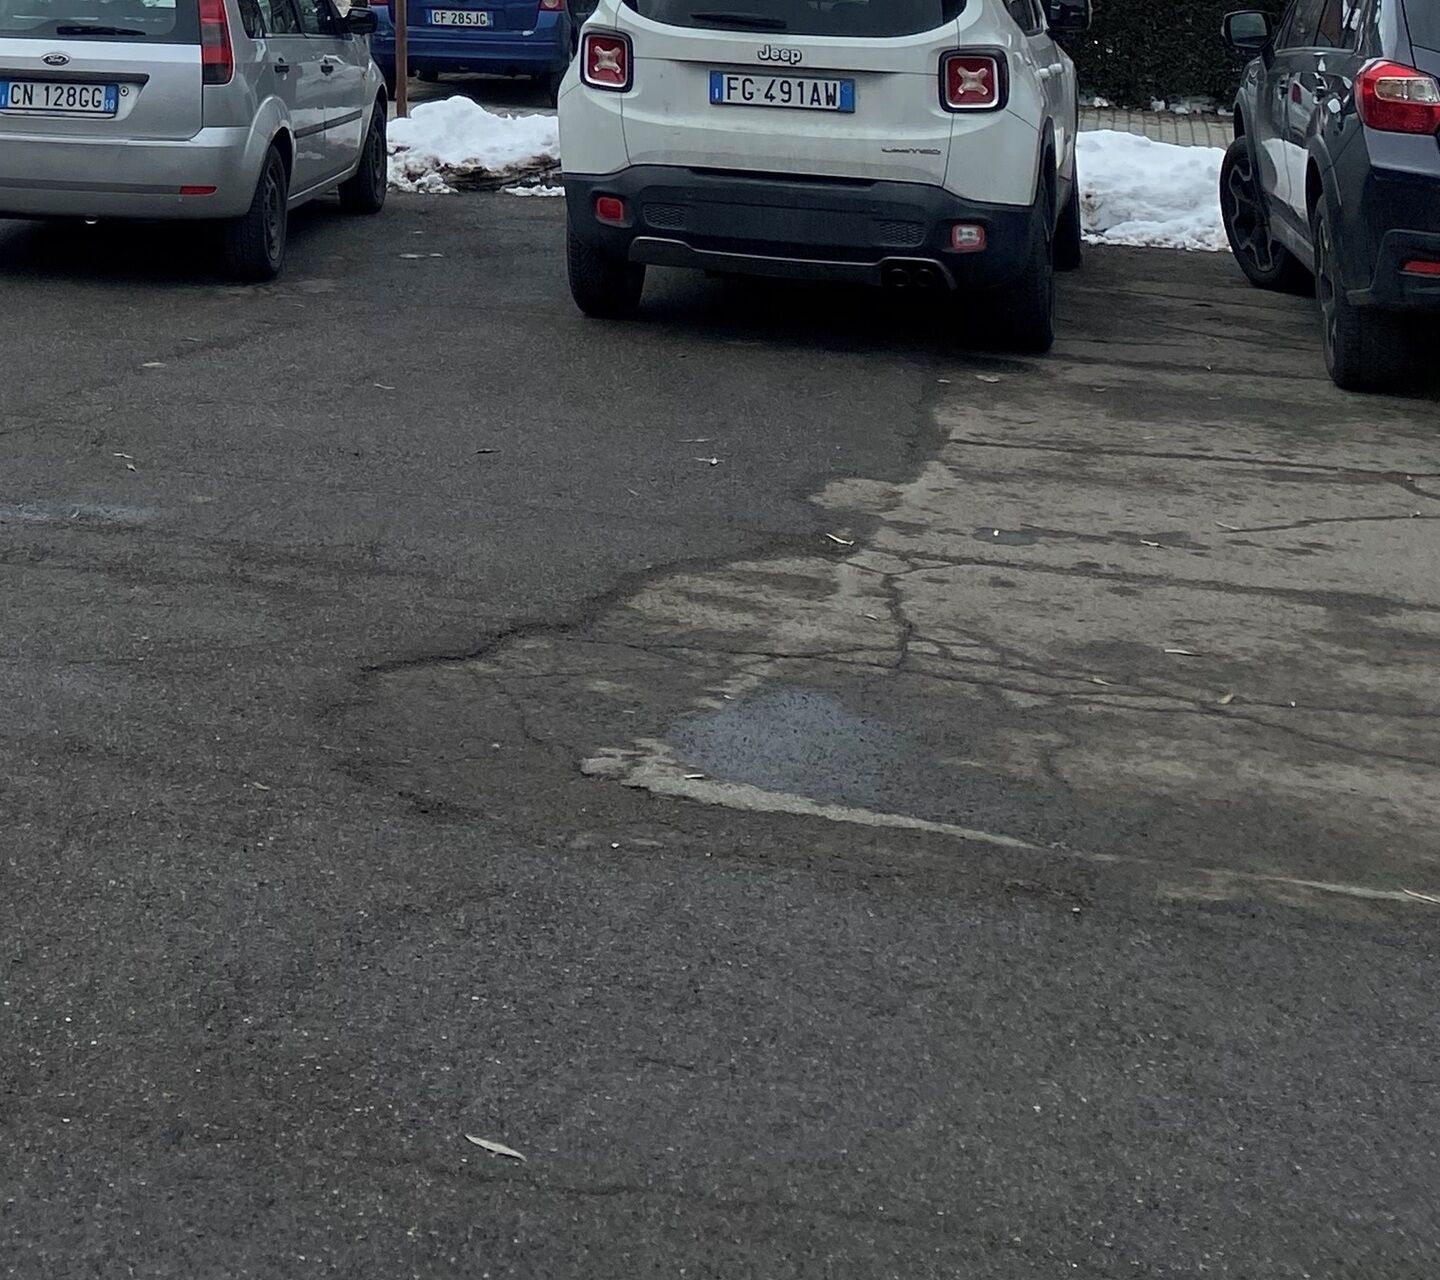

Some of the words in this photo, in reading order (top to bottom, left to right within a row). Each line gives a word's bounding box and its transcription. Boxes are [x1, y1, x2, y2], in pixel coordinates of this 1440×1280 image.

[433, 11, 447, 23] CF
[757, 44, 802, 65] Jeep
[10, 83, 34, 106] CN
[43, 85, 103, 108] 128GG
[726, 76, 755, 101] FG
[763, 78, 837, 107] 491AW
